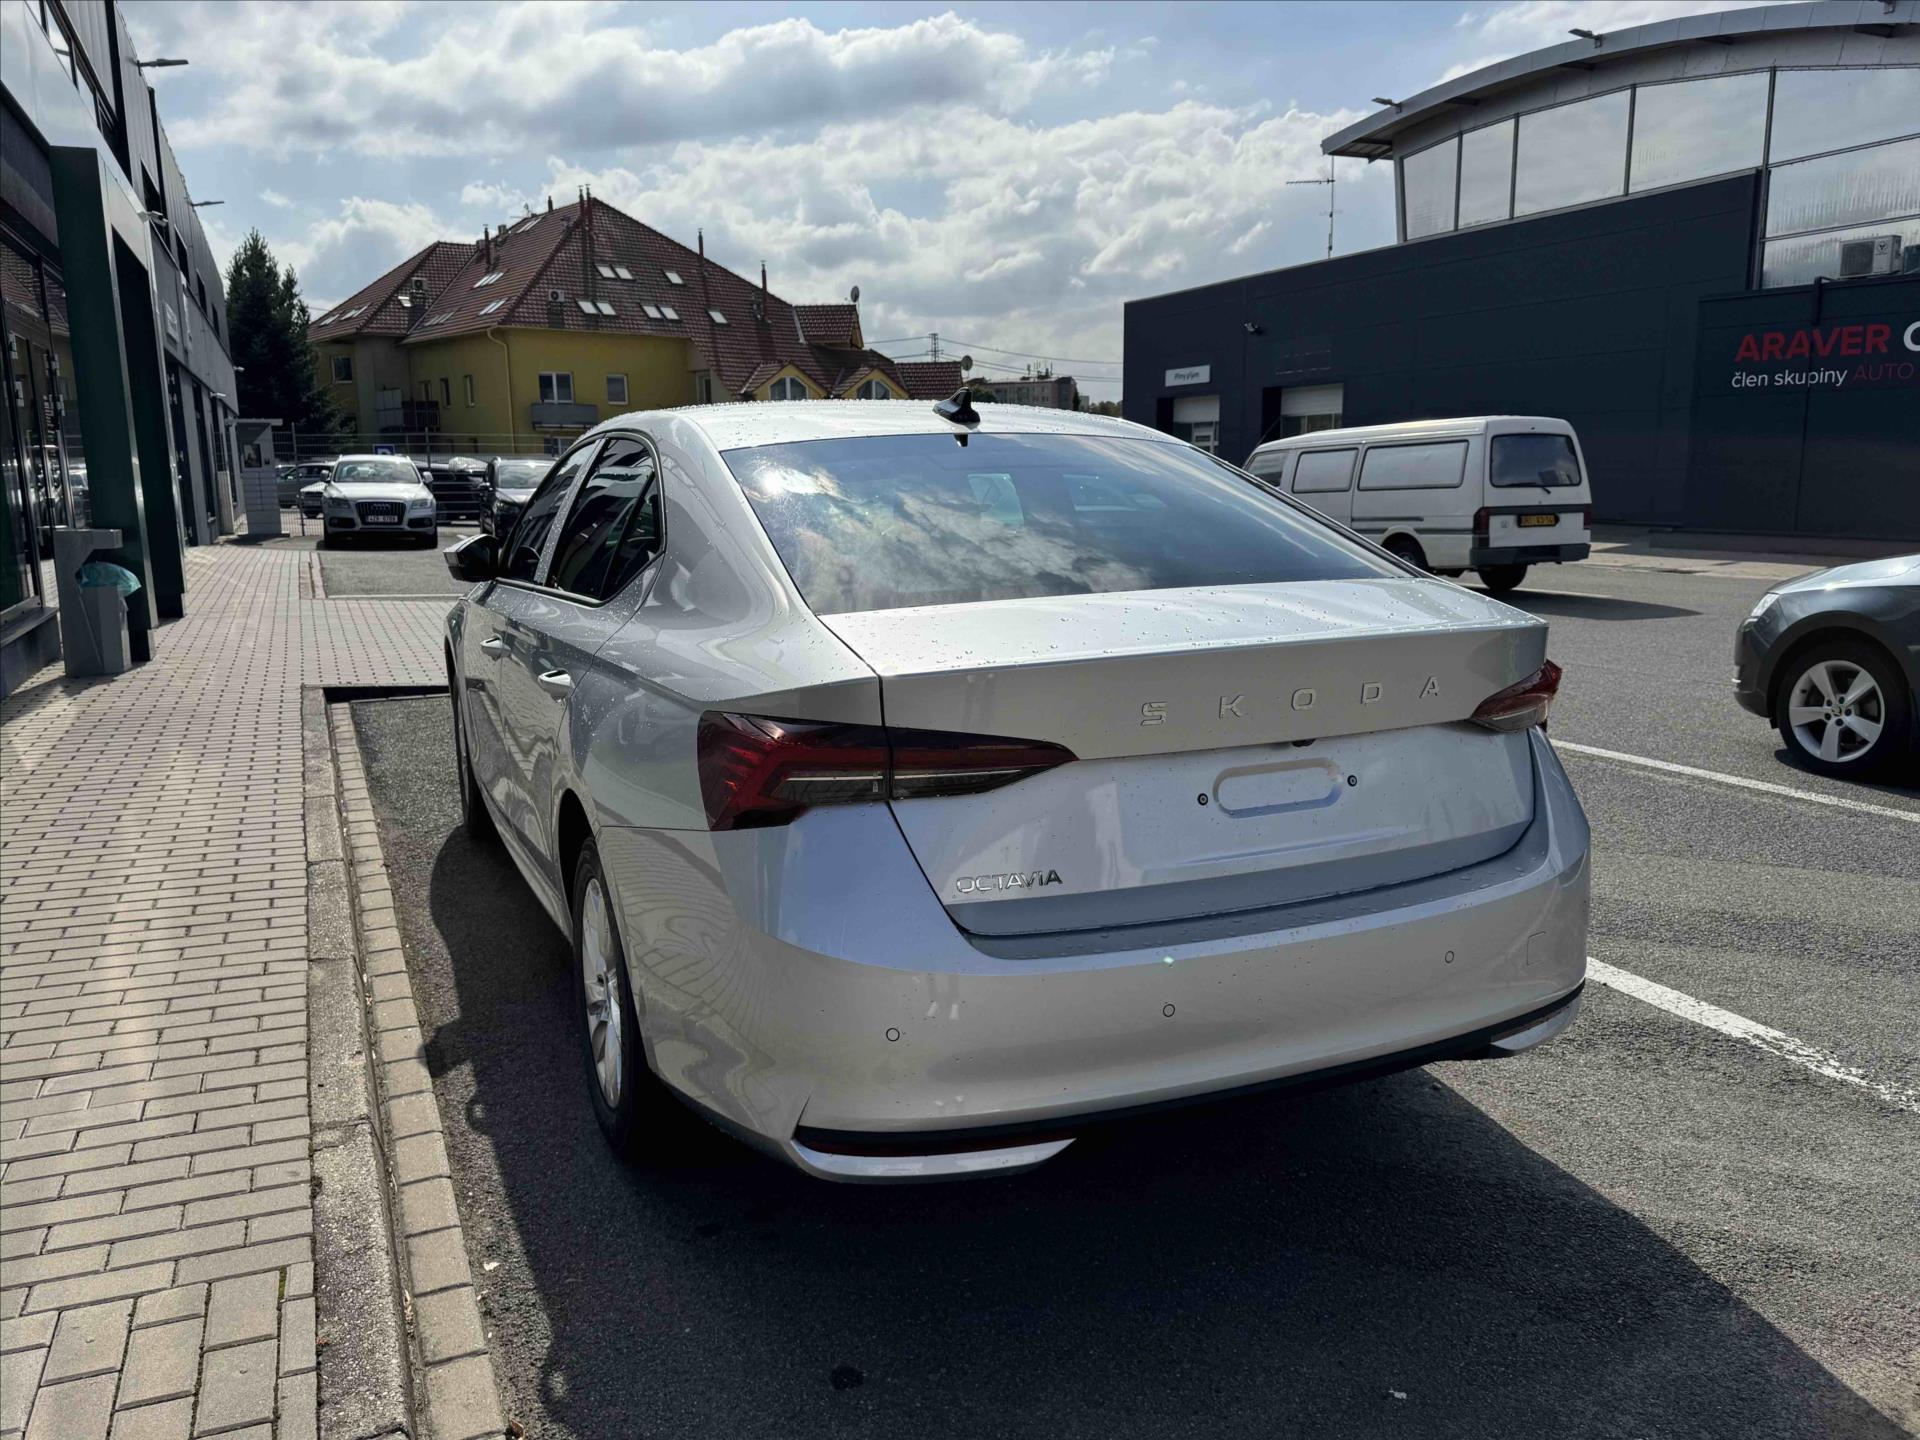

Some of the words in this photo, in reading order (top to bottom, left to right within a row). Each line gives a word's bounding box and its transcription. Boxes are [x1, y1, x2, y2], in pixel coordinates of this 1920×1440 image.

[1734, 324, 1891, 362] ARAVER
[1731, 372, 1768, 388] člen
[1773, 368, 1848, 387] skupiny
[1852, 362, 1914, 381] AUTO
[956, 869, 1063, 893] OCTAVIA
